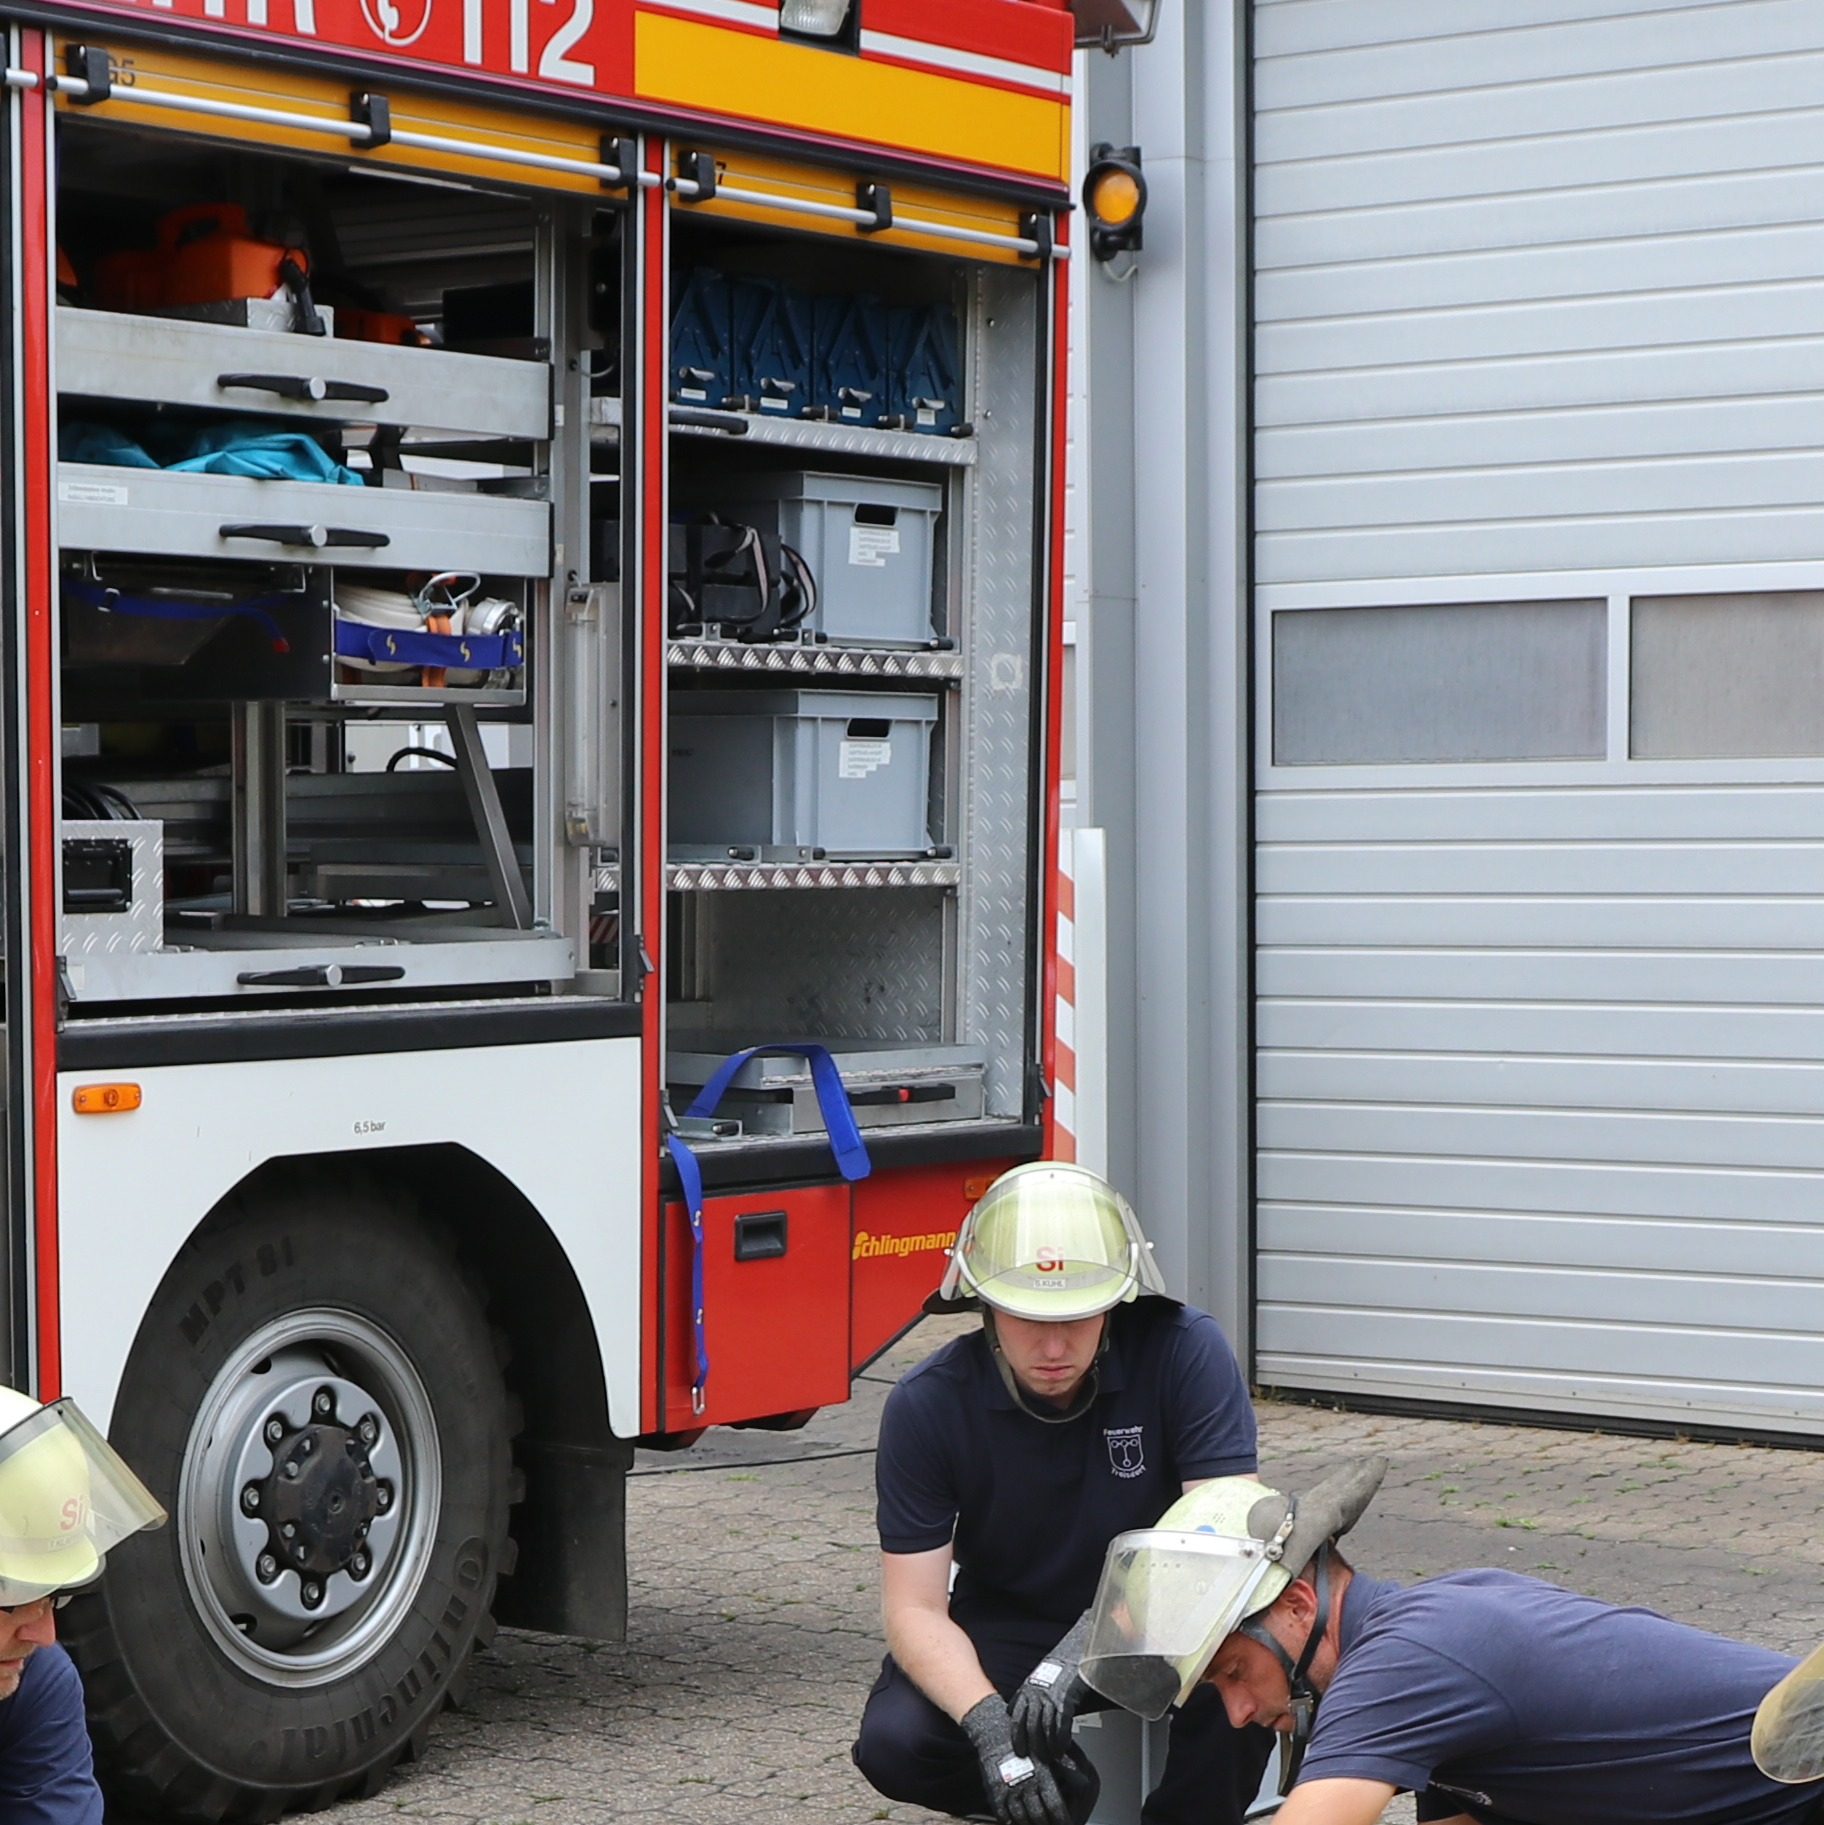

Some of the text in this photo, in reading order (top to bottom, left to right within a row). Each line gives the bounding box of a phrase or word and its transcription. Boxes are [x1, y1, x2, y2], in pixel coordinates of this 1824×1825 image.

[354, 1120, 386, 1135] 6,5 bar
[1036, 1246, 1065, 1272] Si
[59, 1494, 84, 1531] Si
